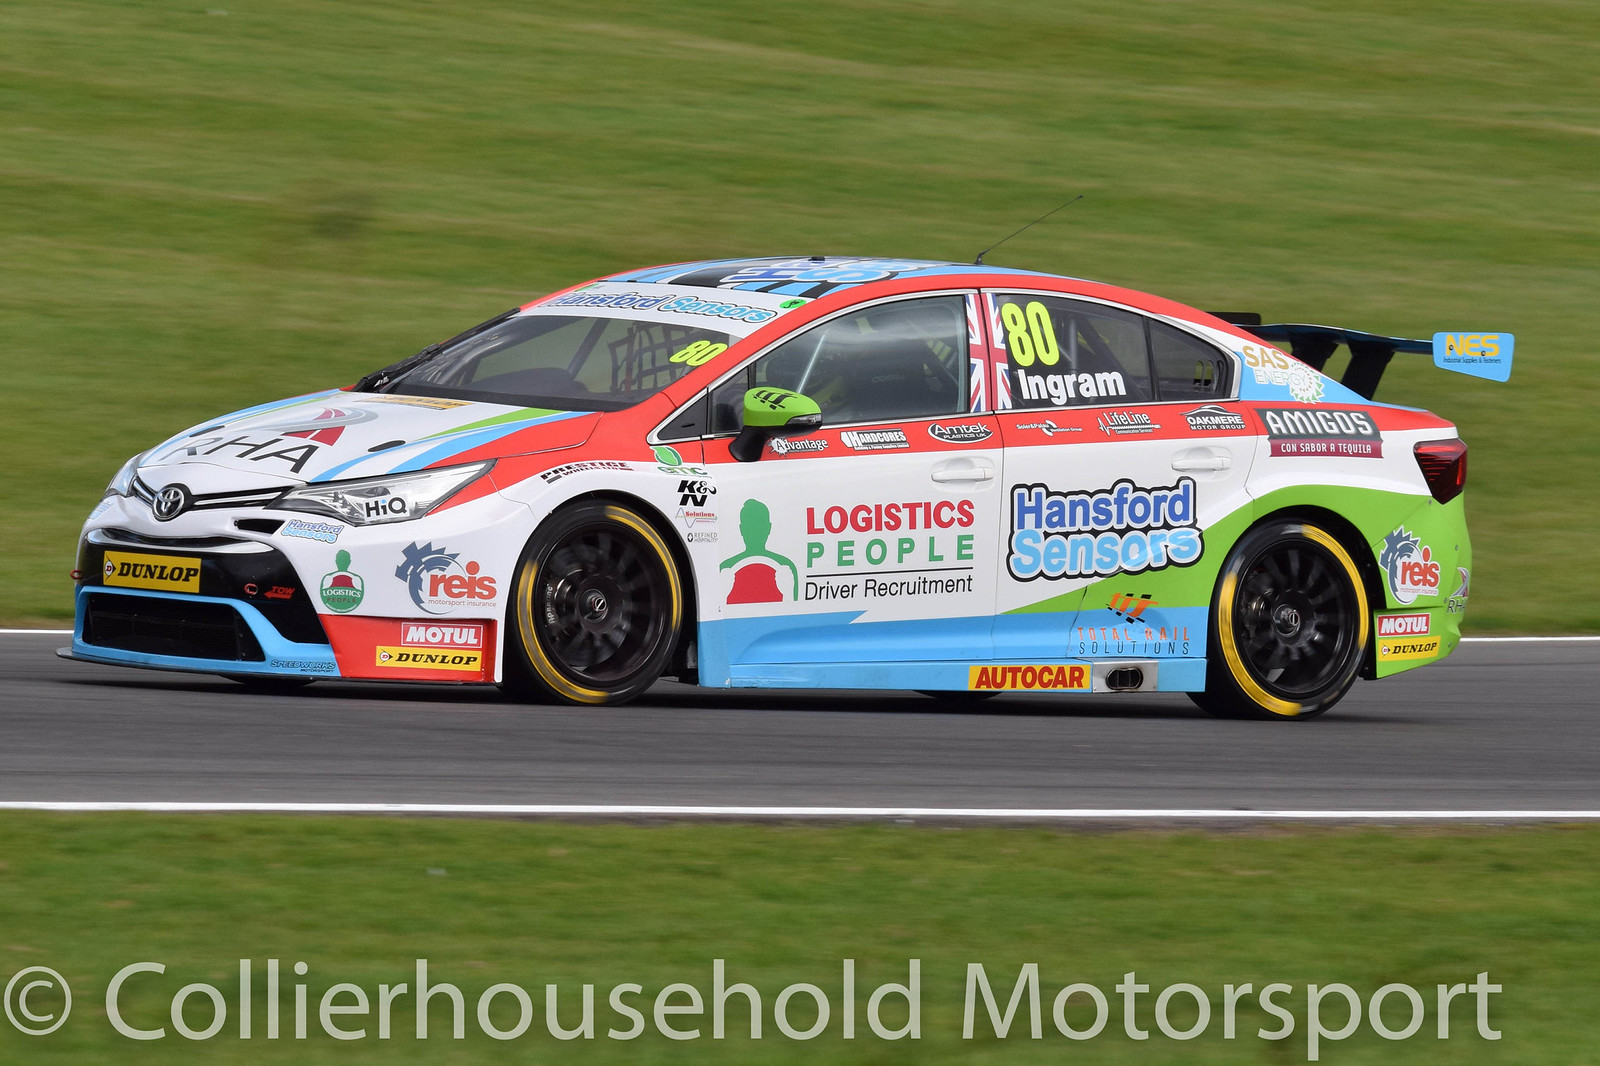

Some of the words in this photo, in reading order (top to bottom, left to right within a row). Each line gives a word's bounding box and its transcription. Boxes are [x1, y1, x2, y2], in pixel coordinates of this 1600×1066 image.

[546, 292, 674, 309] Hansford
[663, 296, 774, 322] Sensors
[1001, 301, 1060, 367] 80
[669, 340, 729, 367] 80
[1445, 334, 1500, 357] NES
[1243, 345, 1290, 370] SAS
[1017, 369, 1127, 405] Ingram
[1255, 369, 1306, 386] ENERGY
[1103, 411, 1151, 426] LifeLine
[1186, 416, 1244, 426] OAKMERE
[1266, 410, 1373, 436] AMIGOS
[934, 422, 989, 435] Amtek
[775, 438, 829, 451] Advantage
[849, 431, 907, 447] HARDCORES
[1281, 443, 1298, 453] CON
[1300, 443, 1328, 453] SABOR
[1330, 444, 1336, 453] A
[1338, 443, 1372, 454] TEQUILA
[540, 461, 630, 481] PRESTIGE
[365, 497, 407, 518] HiQ
[1016, 483, 1191, 531] Hansford
[807, 500, 975, 534] LOGISTICS
[282, 526, 338, 542] Sensors
[287, 520, 342, 534] Hansford
[807, 534, 975, 568] PEOPLE
[1012, 529, 1200, 575] Sensors
[118, 562, 199, 582] DUNLOP
[1400, 547, 1440, 588] reis
[271, 585, 296, 594] TOW
[429, 560, 497, 600] reis
[804, 580, 858, 601] Driver
[865, 574, 973, 598] Recruitment
[322, 588, 362, 598] LOGISTICS
[428, 599, 465, 607] motorsport
[467, 599, 497, 607] insurance
[1077, 627, 1132, 641] TOTAL
[1144, 627, 1190, 641] RAIL
[1380, 616, 1428, 634] MOTUL
[405, 626, 479, 644] MOTUL
[1079, 641, 1190, 655] SOLUTIONS
[1391, 642, 1438, 655] DUNLOP
[395, 653, 478, 666] DUNLOP
[975, 665, 1085, 689] AUTOCAR
